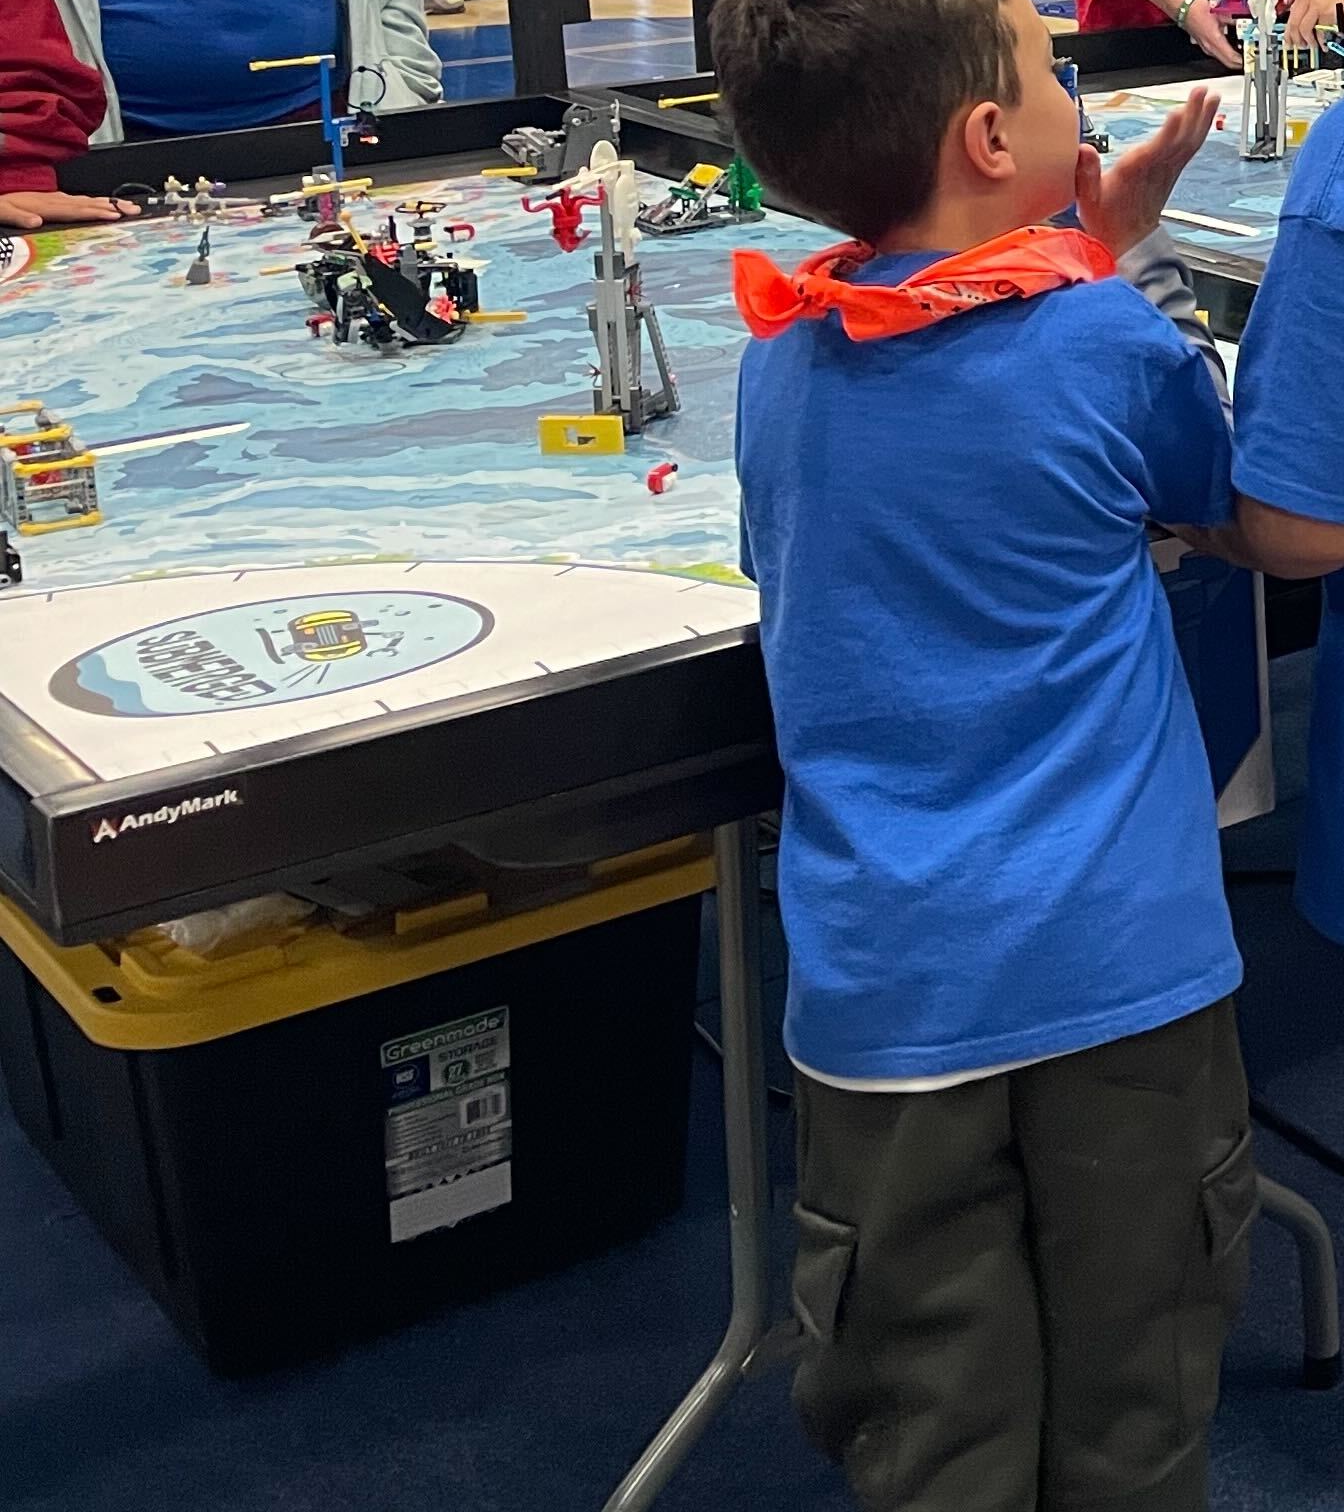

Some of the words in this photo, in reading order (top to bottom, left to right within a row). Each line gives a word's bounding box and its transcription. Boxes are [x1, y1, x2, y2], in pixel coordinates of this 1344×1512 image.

[137, 631, 277, 702] SUBMERGED
[119, 789, 239, 832] AndyMark
[386, 1017, 500, 1060] Greenmade
[438, 1037, 497, 1058] STORAGE
